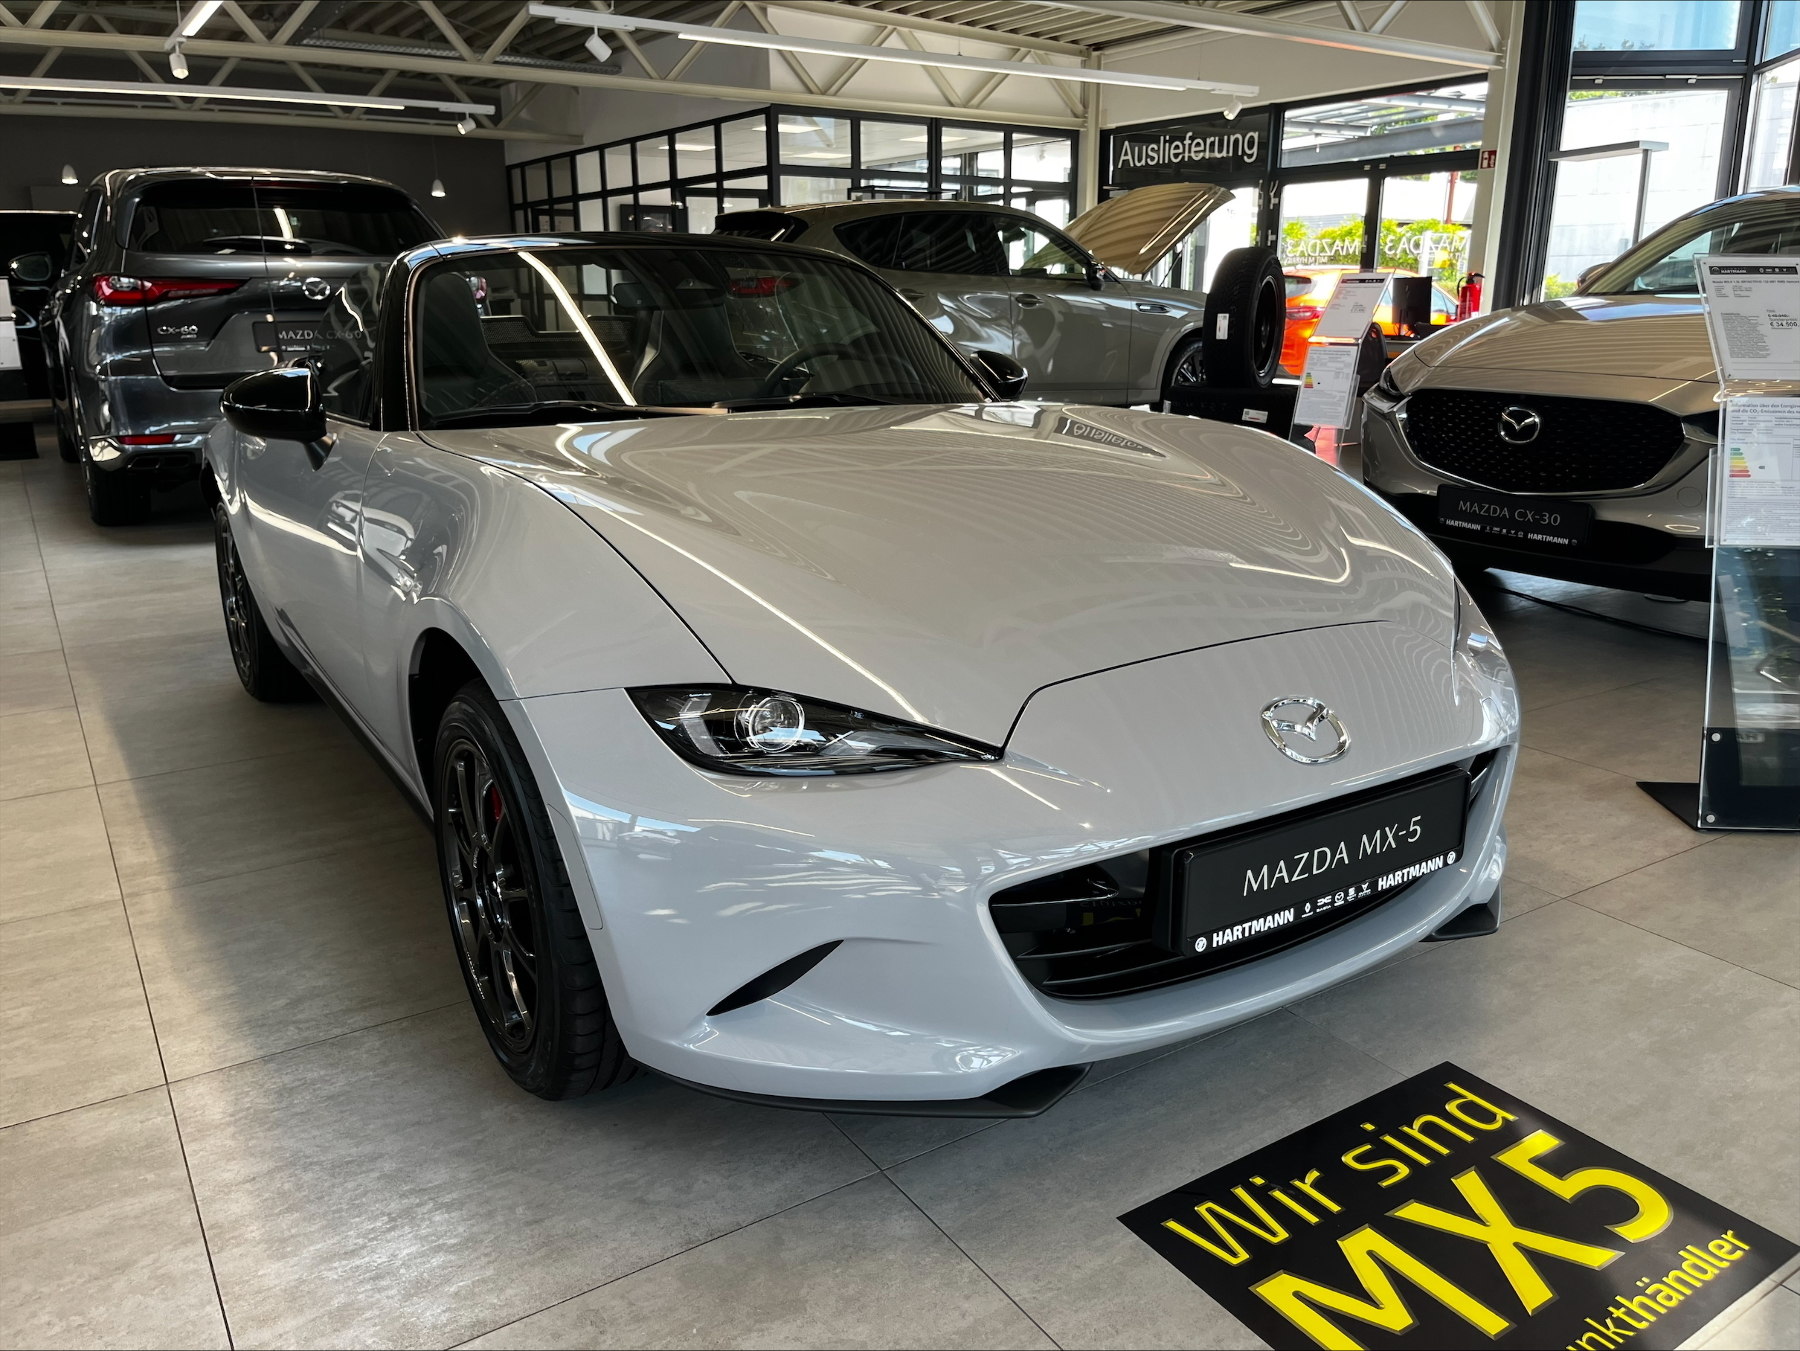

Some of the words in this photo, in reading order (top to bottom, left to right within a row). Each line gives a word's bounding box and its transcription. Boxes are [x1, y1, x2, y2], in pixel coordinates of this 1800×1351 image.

[1118, 131, 1259, 168] Auslieferung
[156, 325, 199, 335] CX-60
[1446, 519, 1481, 531] HARTMANN
[1528, 532, 1569, 545] HARTMANN
[1458, 500, 1509, 519] MAZDA
[1515, 508, 1561, 526] CX-30
[1243, 841, 1349, 896] MAZDA
[1359, 815, 1421, 859] MX-5
[1212, 907, 1294, 947] HARTMANN
[1378, 856, 1443, 891] HARTMANN
[1161, 1168, 1347, 1266] Wir
[1341, 1081, 1518, 1189] sind
[1248, 1128, 1674, 1350] MX5
[1566, 1229, 1750, 1350] nkthändler
